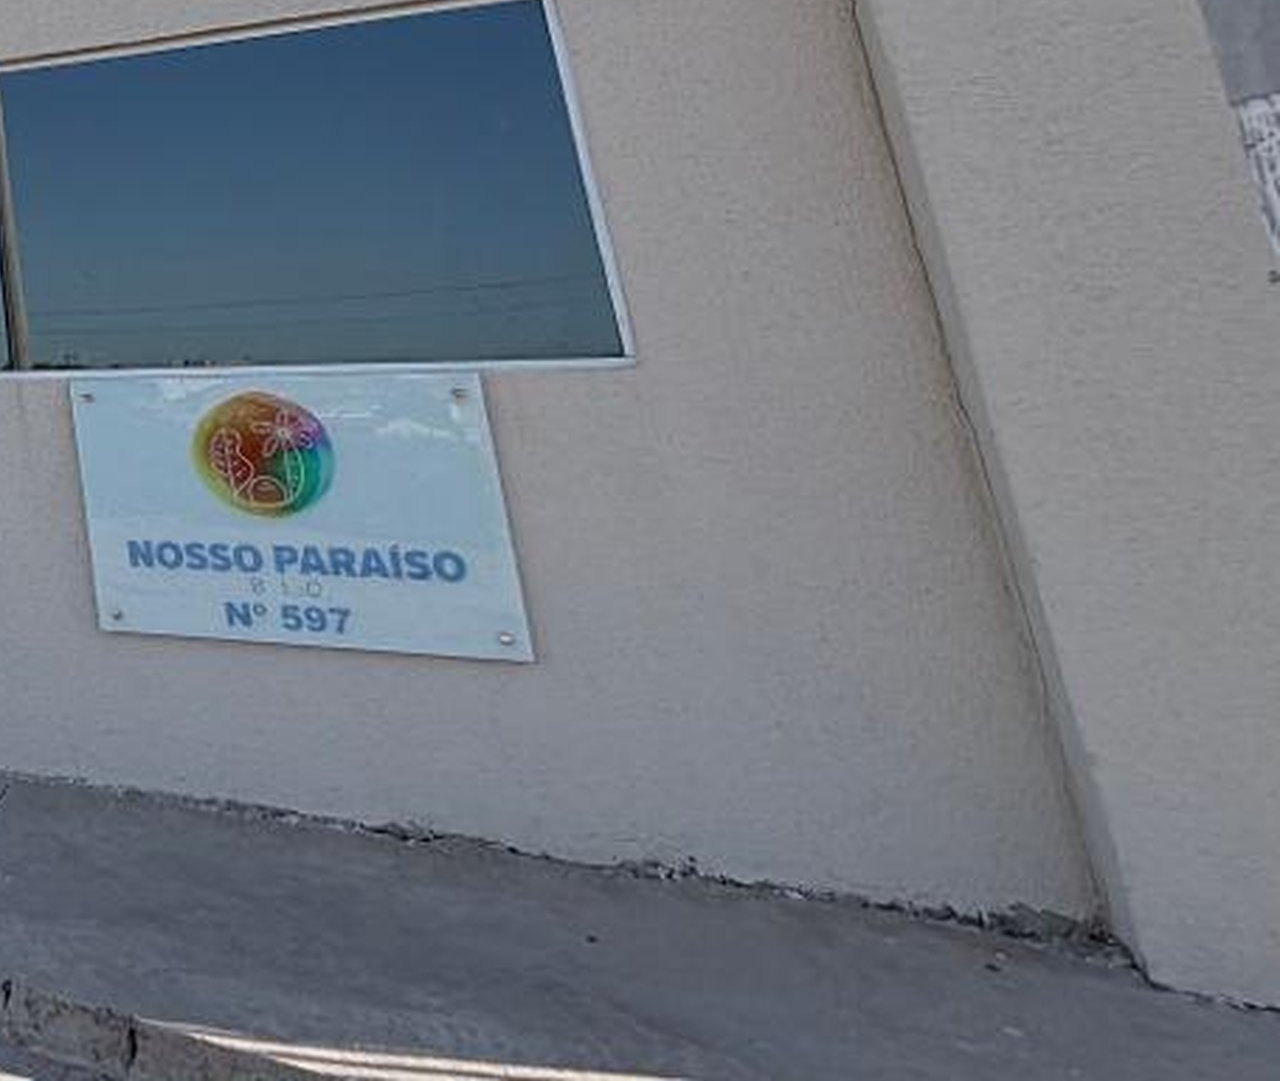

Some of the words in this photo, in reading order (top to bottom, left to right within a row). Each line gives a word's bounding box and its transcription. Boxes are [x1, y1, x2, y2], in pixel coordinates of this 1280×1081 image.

[126, 539, 264, 573] NOSSO
[273, 543, 467, 583] PARAÍSO
[280, 604, 351, 634] 597
